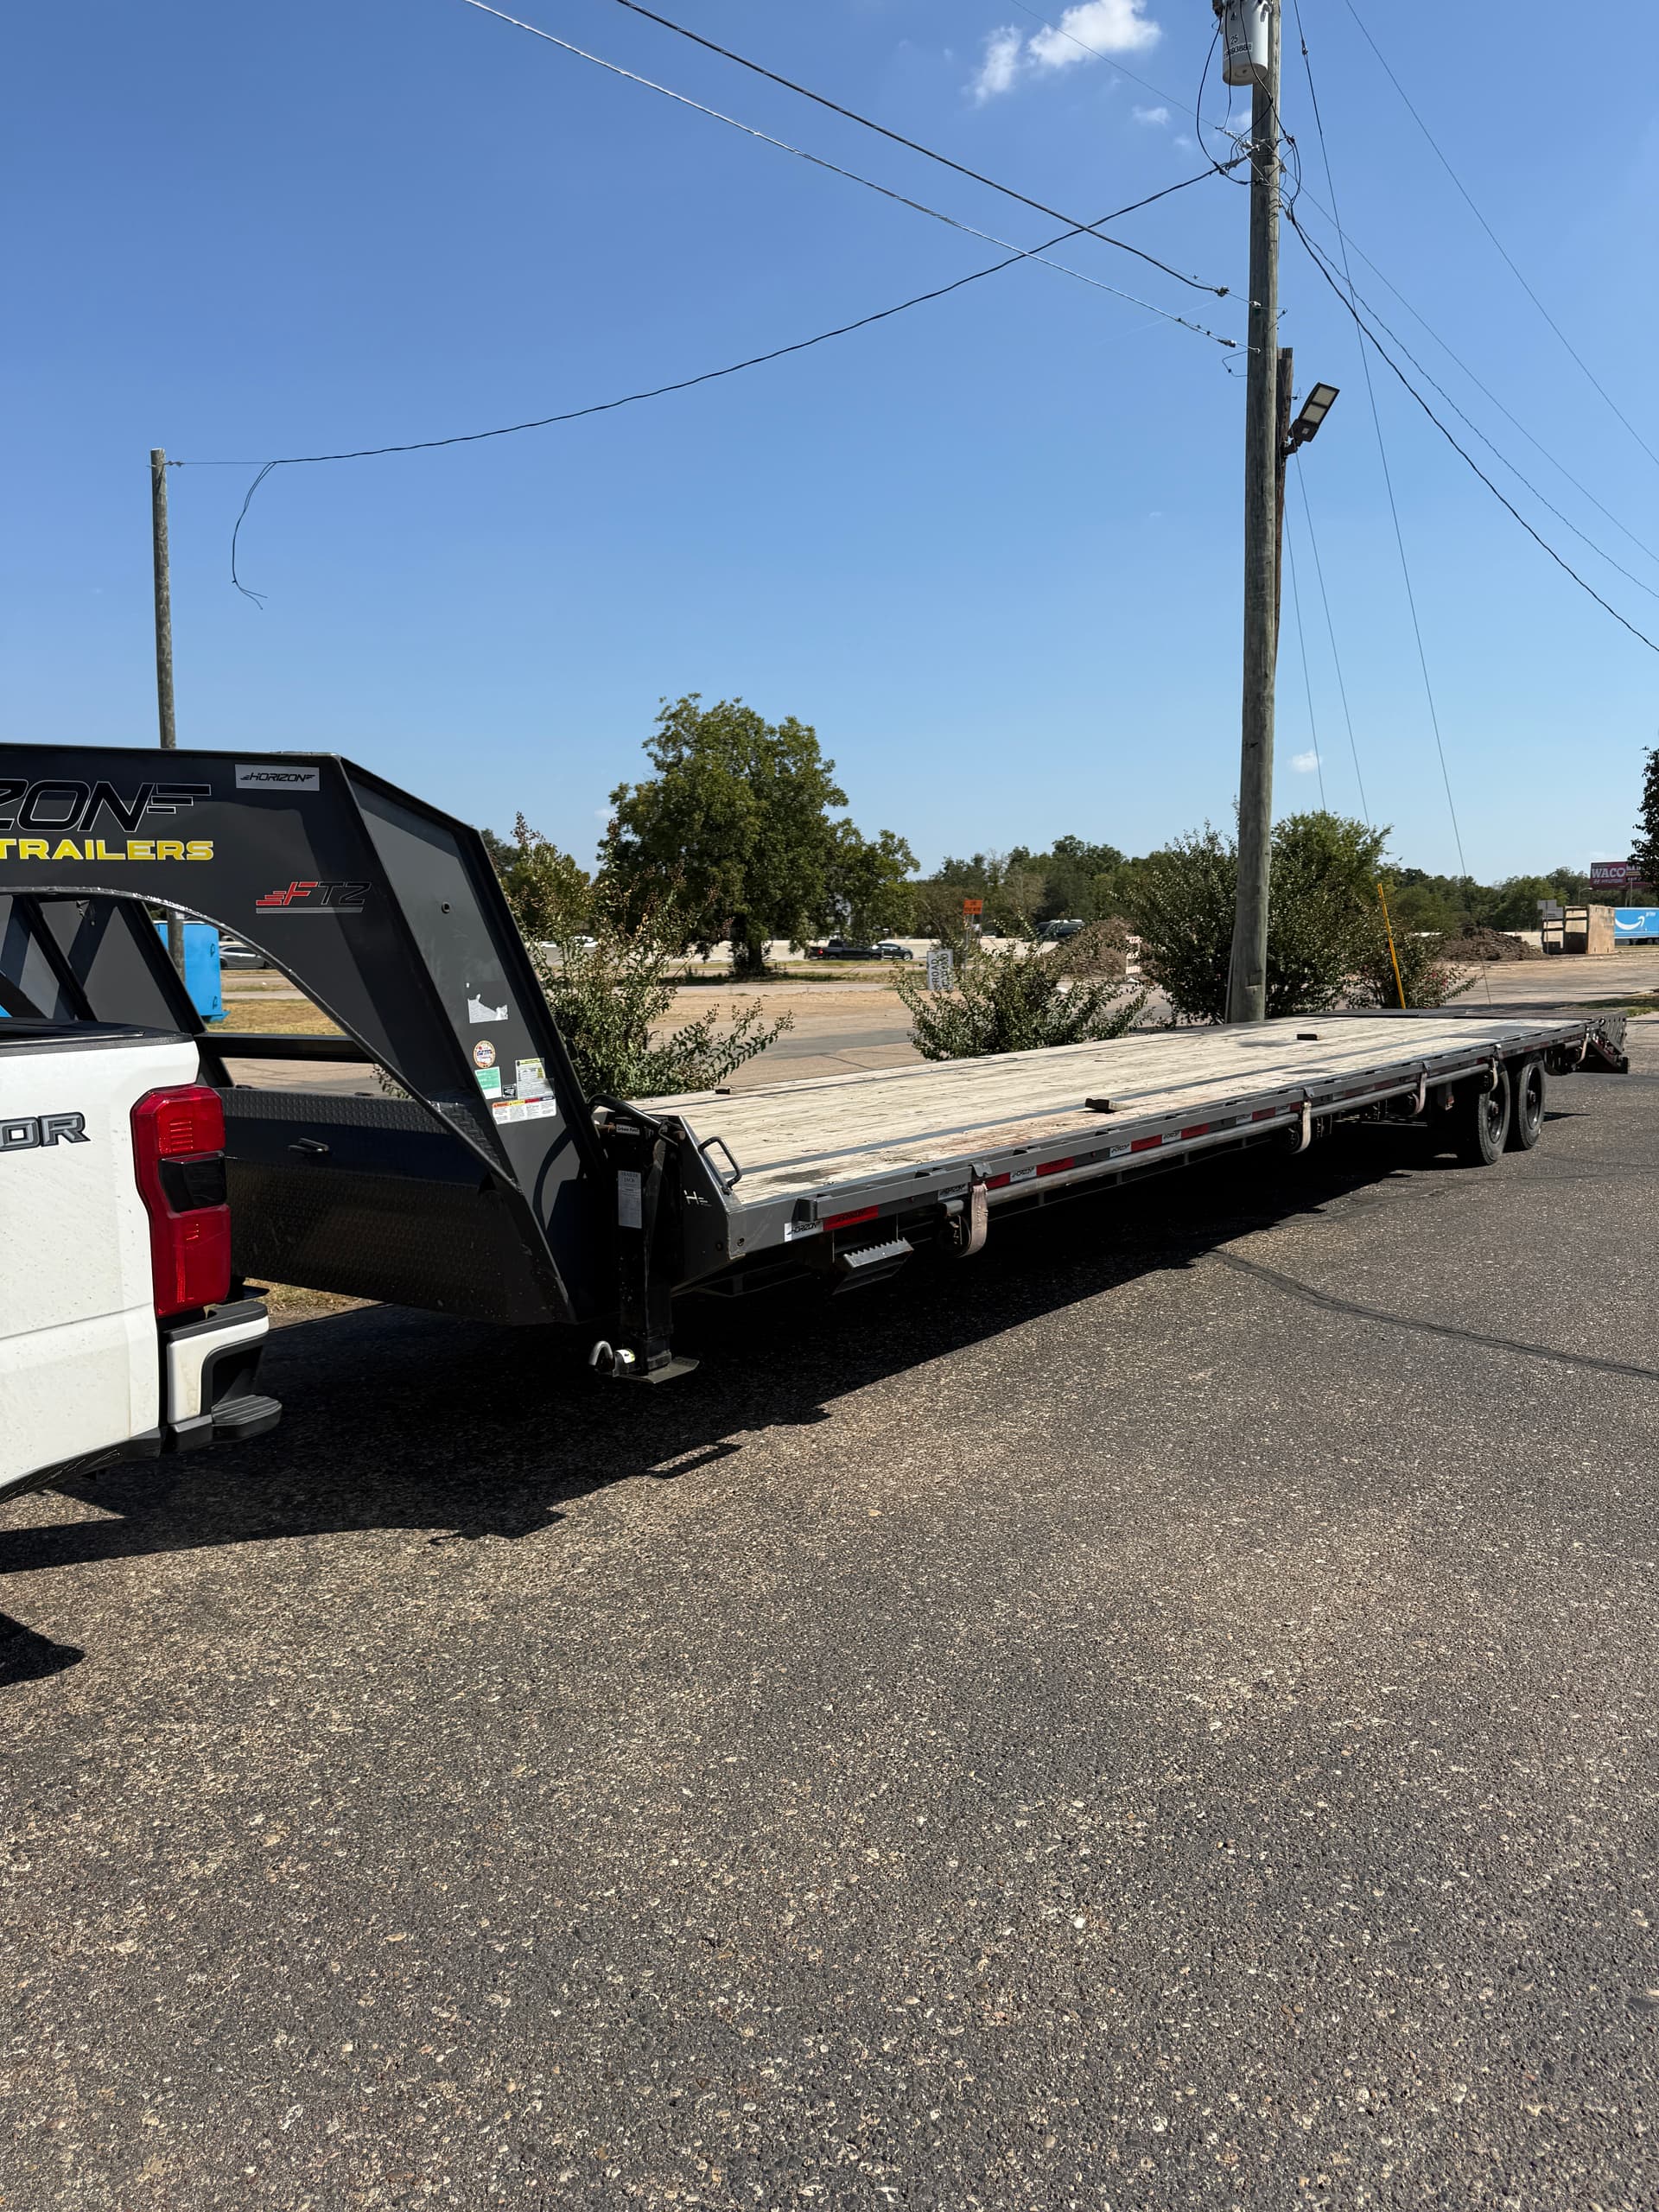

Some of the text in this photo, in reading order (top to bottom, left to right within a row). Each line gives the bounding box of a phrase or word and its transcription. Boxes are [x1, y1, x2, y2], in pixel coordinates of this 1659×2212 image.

[1230, 35, 1238, 44] 25
[249, 772, 308, 782] HORIZON
[0, 838, 214, 861] TRAILERS
[1592, 868, 1625, 878] WACO
